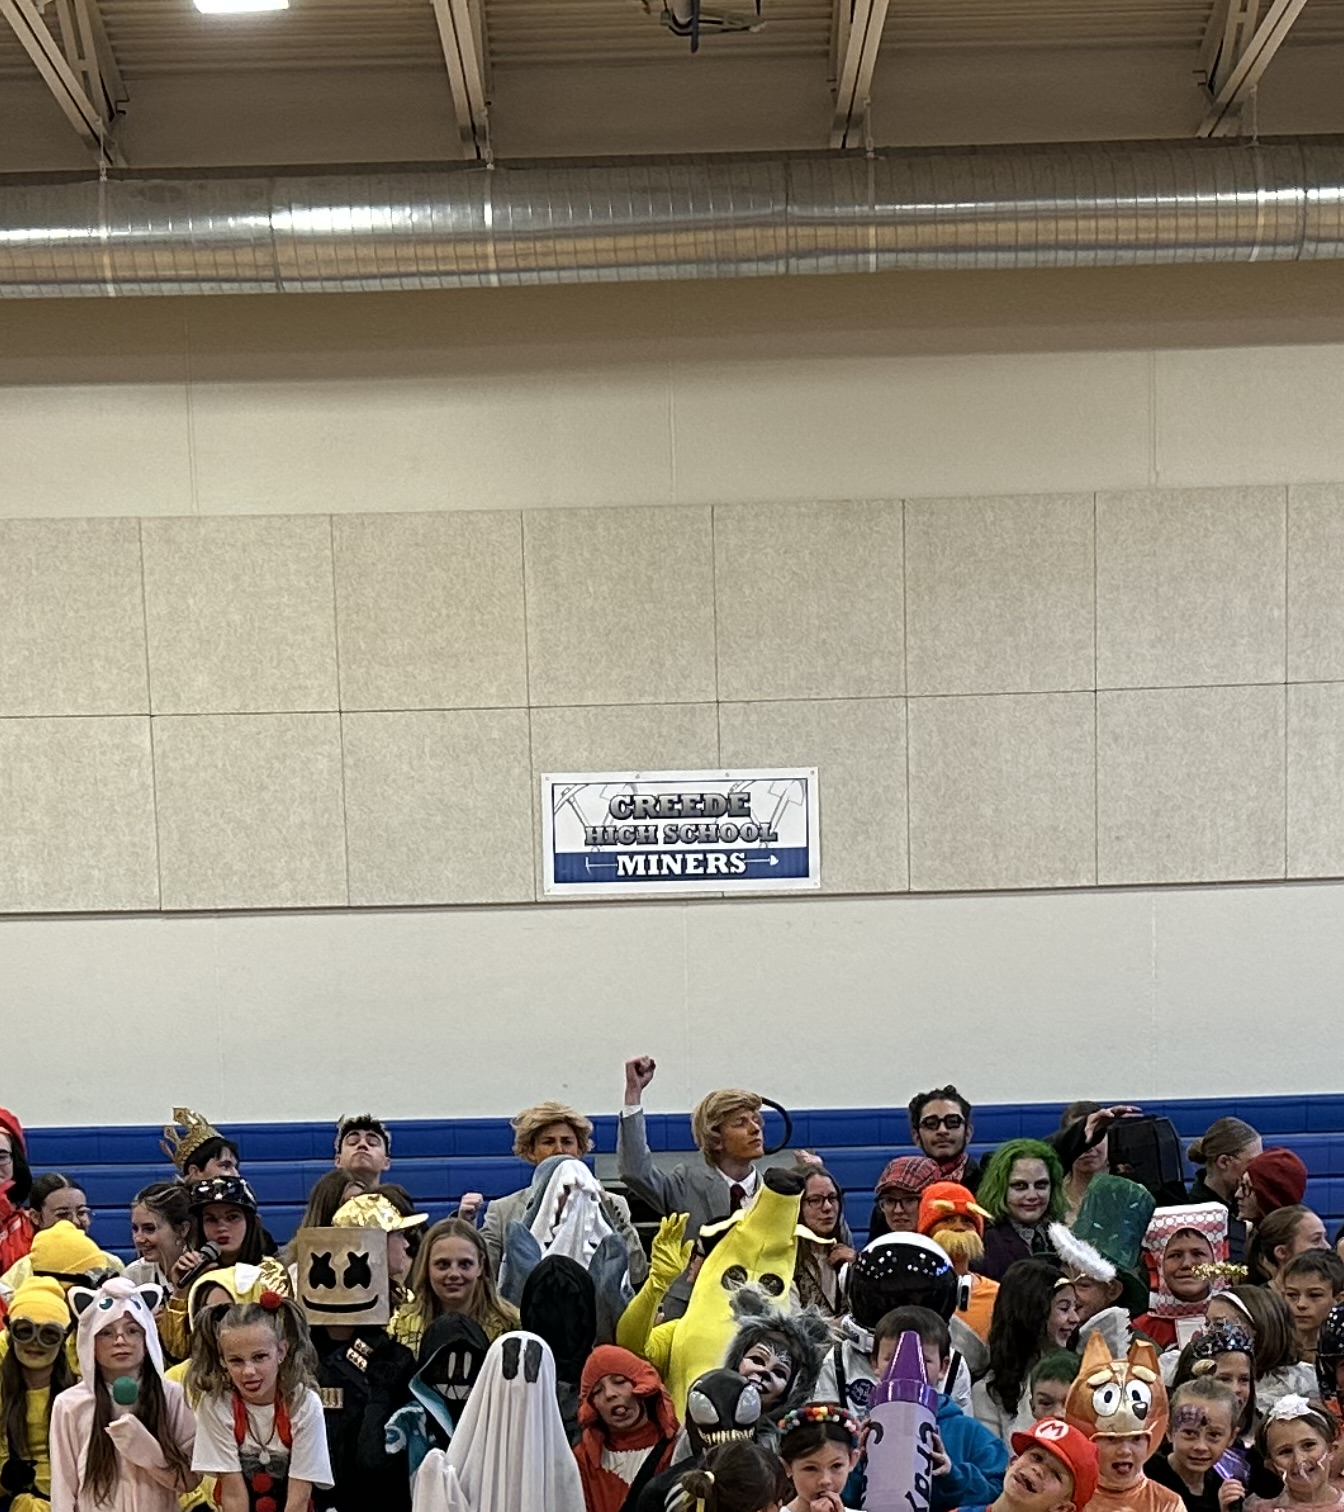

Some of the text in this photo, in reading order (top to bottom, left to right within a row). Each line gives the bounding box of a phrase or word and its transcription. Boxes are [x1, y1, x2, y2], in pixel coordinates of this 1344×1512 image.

[609, 792, 751, 820] CREEDE
[585, 822, 778, 846] HIGH SCHOOL
[617, 852, 747, 877] MINERS
[1039, 1423, 1064, 1436] M
